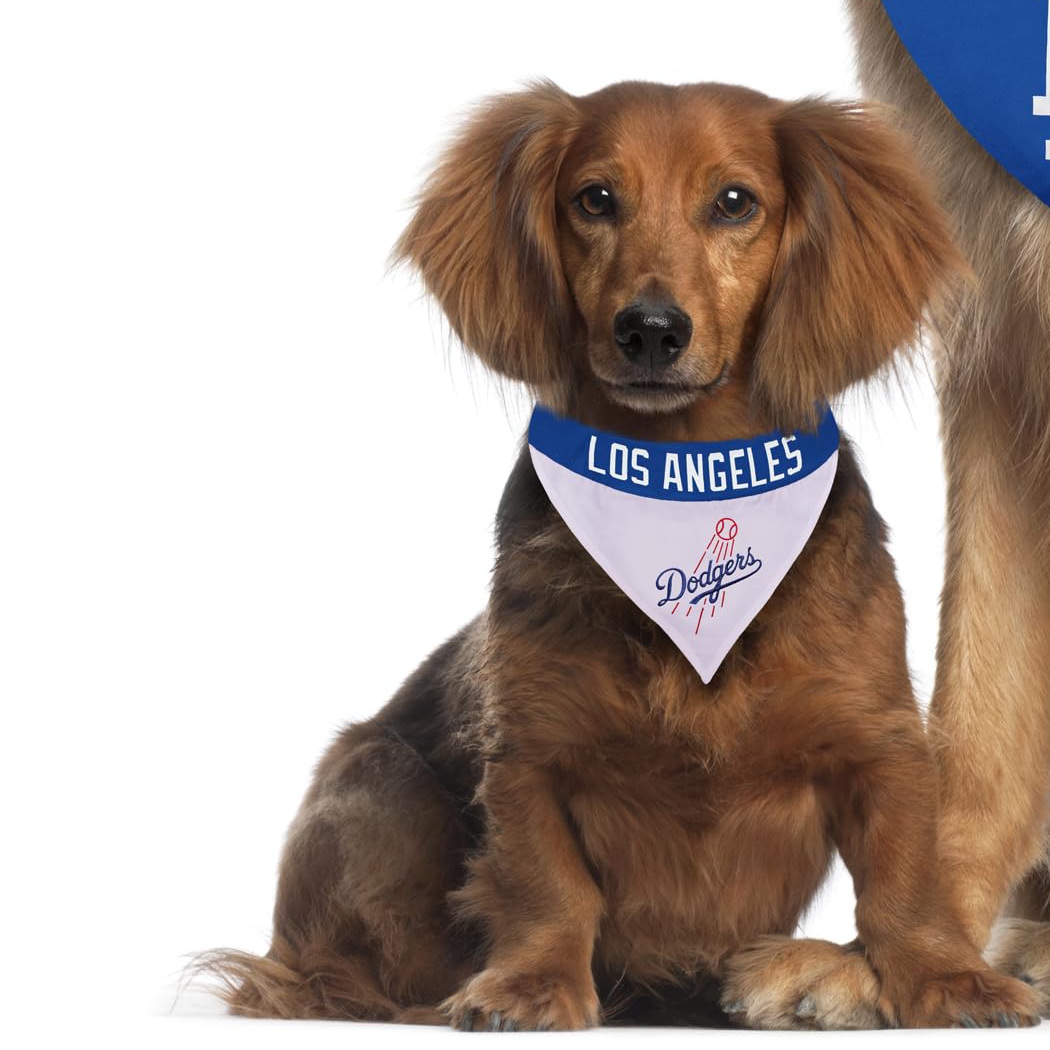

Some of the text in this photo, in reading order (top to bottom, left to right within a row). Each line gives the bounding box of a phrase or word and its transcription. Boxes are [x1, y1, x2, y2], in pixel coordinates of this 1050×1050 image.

[588, 435, 803, 492] LOS ANGELES
[655, 546, 762, 607] Dodgers
